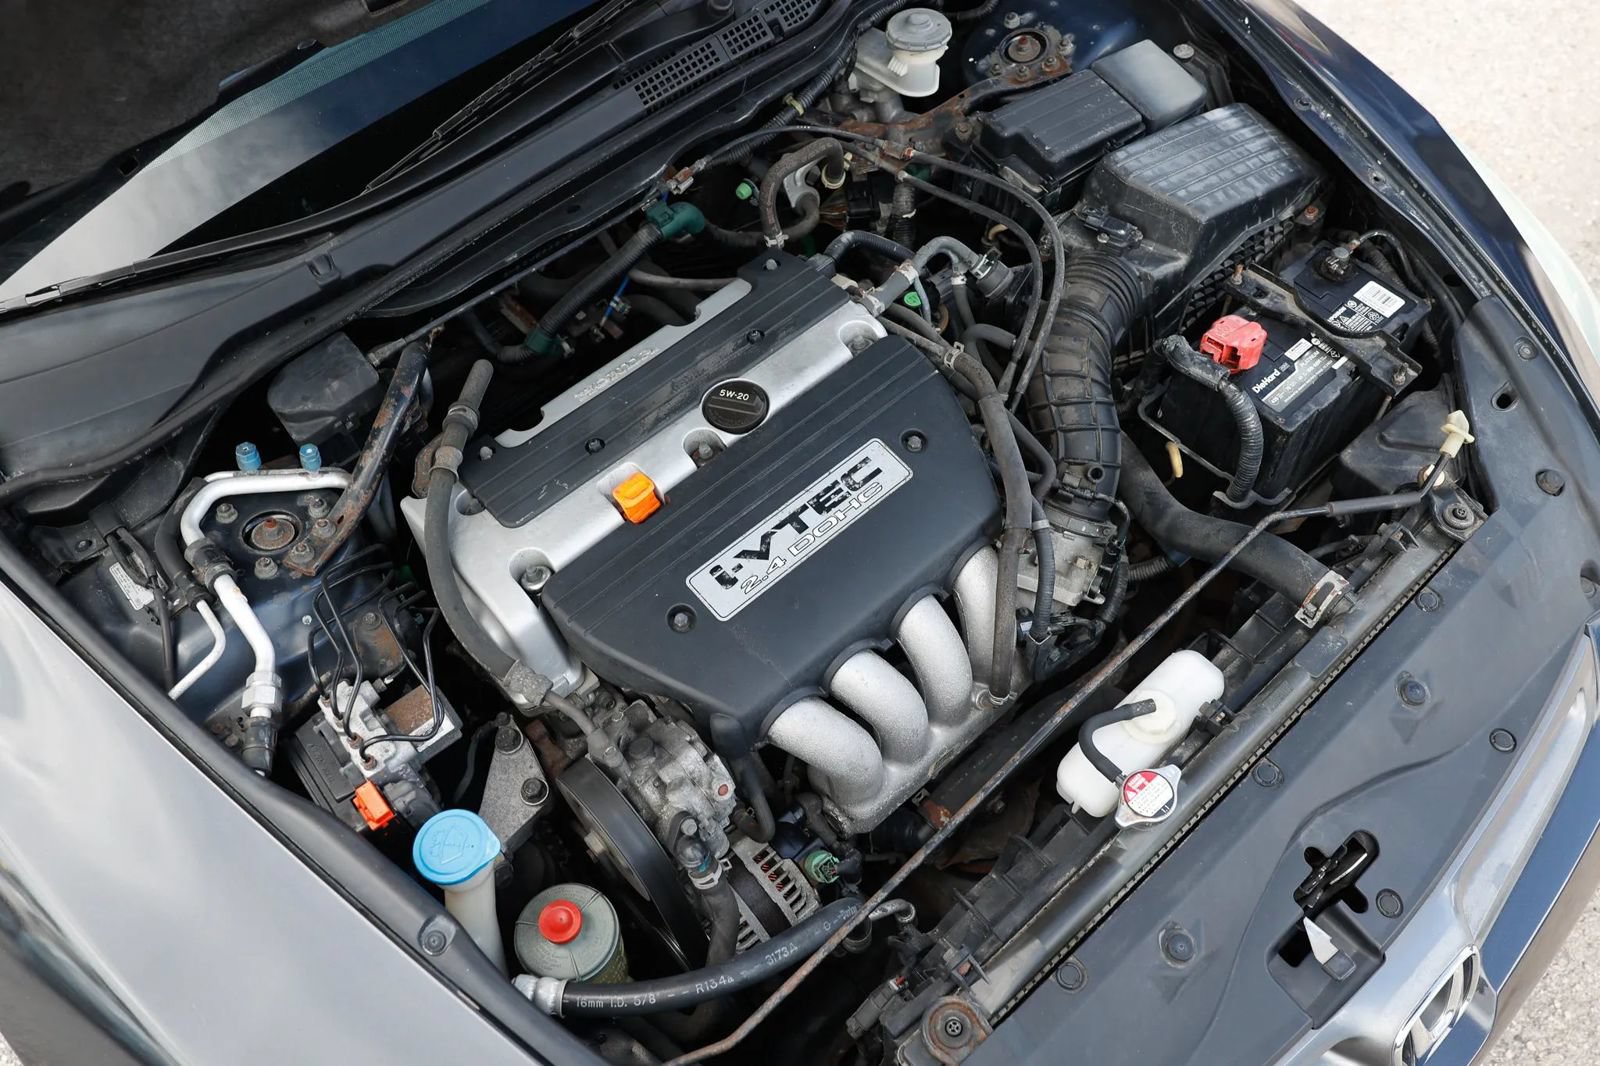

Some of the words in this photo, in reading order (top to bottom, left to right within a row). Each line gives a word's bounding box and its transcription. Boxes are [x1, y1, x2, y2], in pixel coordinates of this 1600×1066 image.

[719, 389, 750, 401] 5W-20
[1251, 368, 1281, 394] DieHard
[740, 555, 788, 595] 2.4
[787, 481, 884, 557] DOHC
[576, 997, 604, 1009] 16mm
[695, 975, 735, 995] R134a
